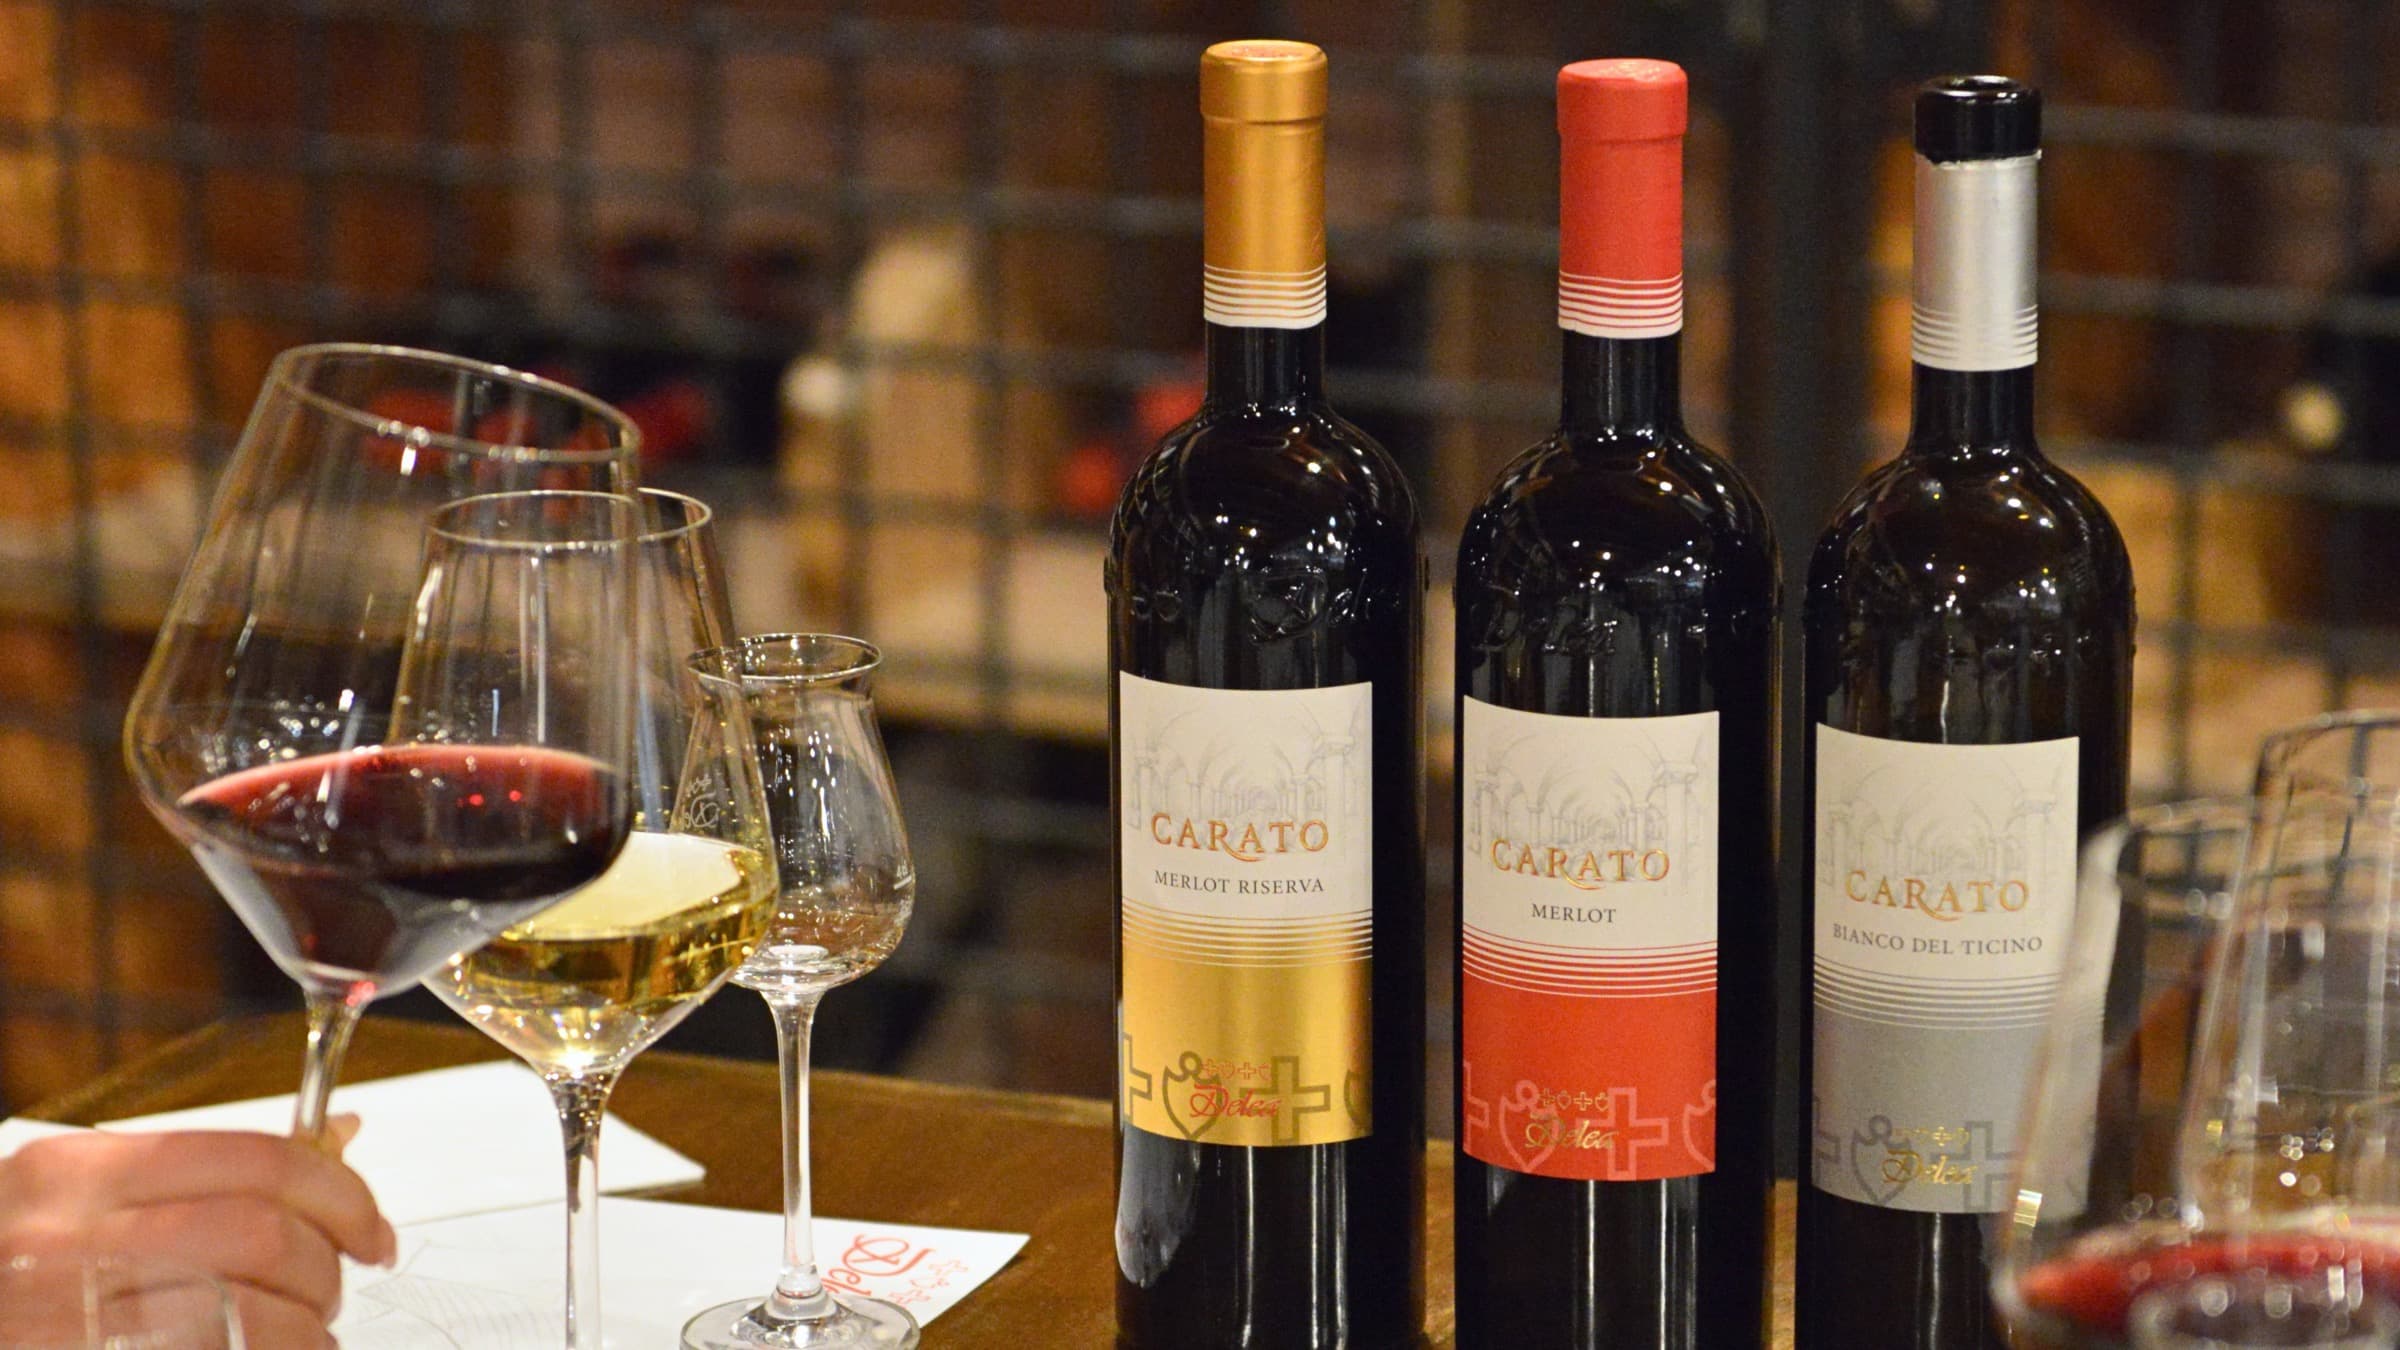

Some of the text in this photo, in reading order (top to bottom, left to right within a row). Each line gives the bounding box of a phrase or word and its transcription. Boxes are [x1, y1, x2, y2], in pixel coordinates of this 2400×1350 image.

[1151, 812, 1330, 863] CARATO
[1154, 870, 1325, 895] MERLOT RISERVA
[1490, 838, 1671, 891] CARATO
[1531, 903, 1617, 924] MERLOT
[1844, 869, 2030, 922] CARATO
[1832, 923, 2043, 956] BIANCO DEL TICINO
